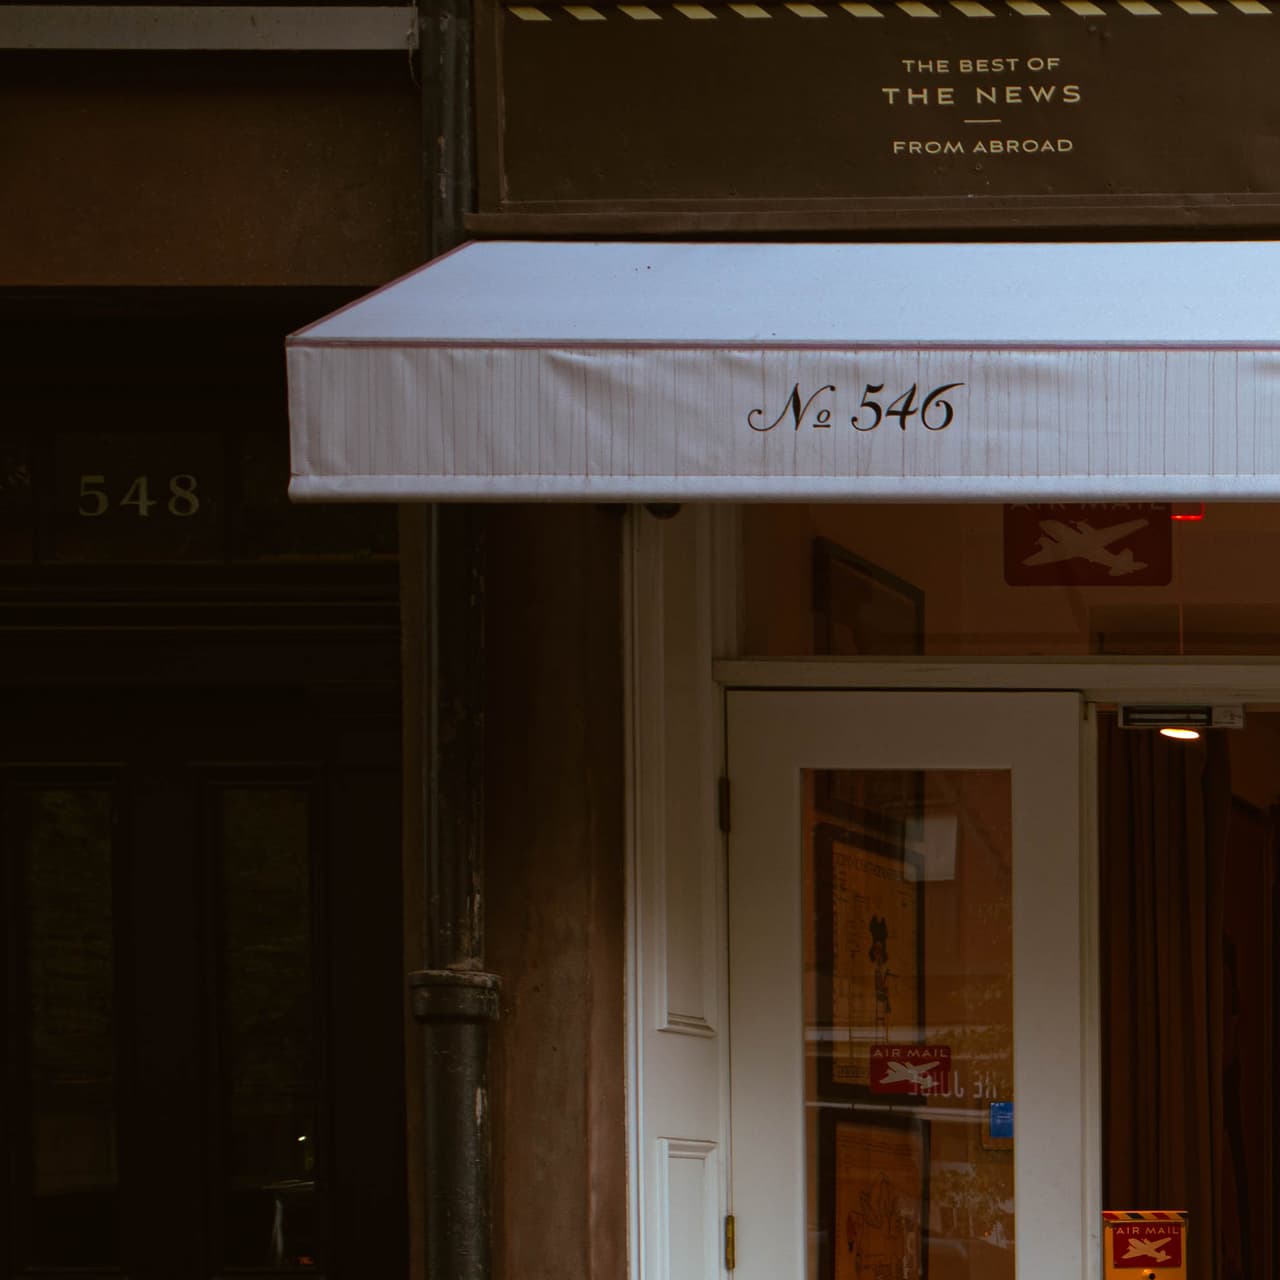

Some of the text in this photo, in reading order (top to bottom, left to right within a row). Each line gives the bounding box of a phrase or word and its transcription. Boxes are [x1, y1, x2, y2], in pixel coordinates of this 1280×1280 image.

[902, 57, 1061, 73] THE BEST OF
[881, 85, 1082, 105] THE NEWS
[893, 139, 1073, 155] FROM ABROAD
[851, 382, 966, 432] 546
[78, 473, 200, 517] 548
[873, 1048, 949, 1057] AIR MAIL
[1116, 1225, 1180, 1235] AIR MAIL
